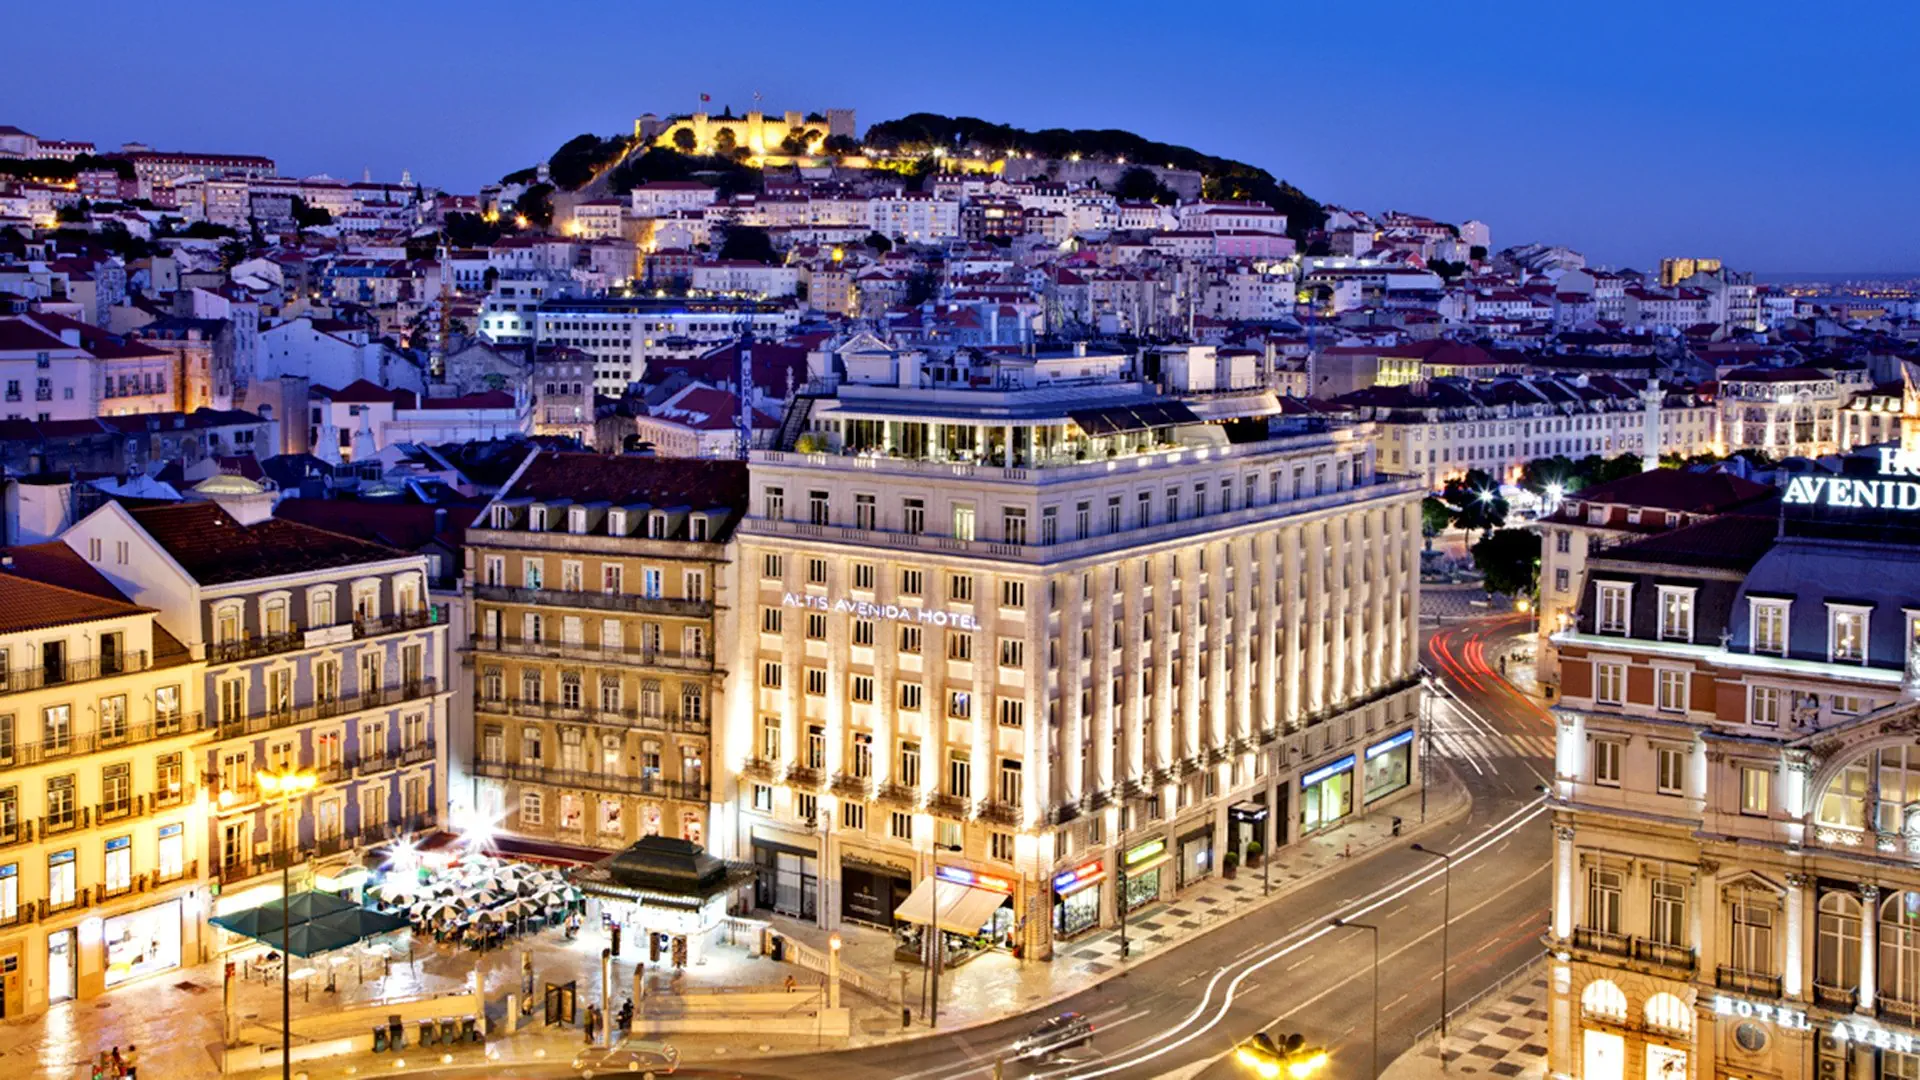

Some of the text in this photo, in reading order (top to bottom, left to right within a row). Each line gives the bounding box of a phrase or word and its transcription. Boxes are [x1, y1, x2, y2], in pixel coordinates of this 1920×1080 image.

[783, 593, 981, 629] ALTIS AVENIDA HOTEL
[1715, 996, 1913, 1053] HOTEL AVEN
